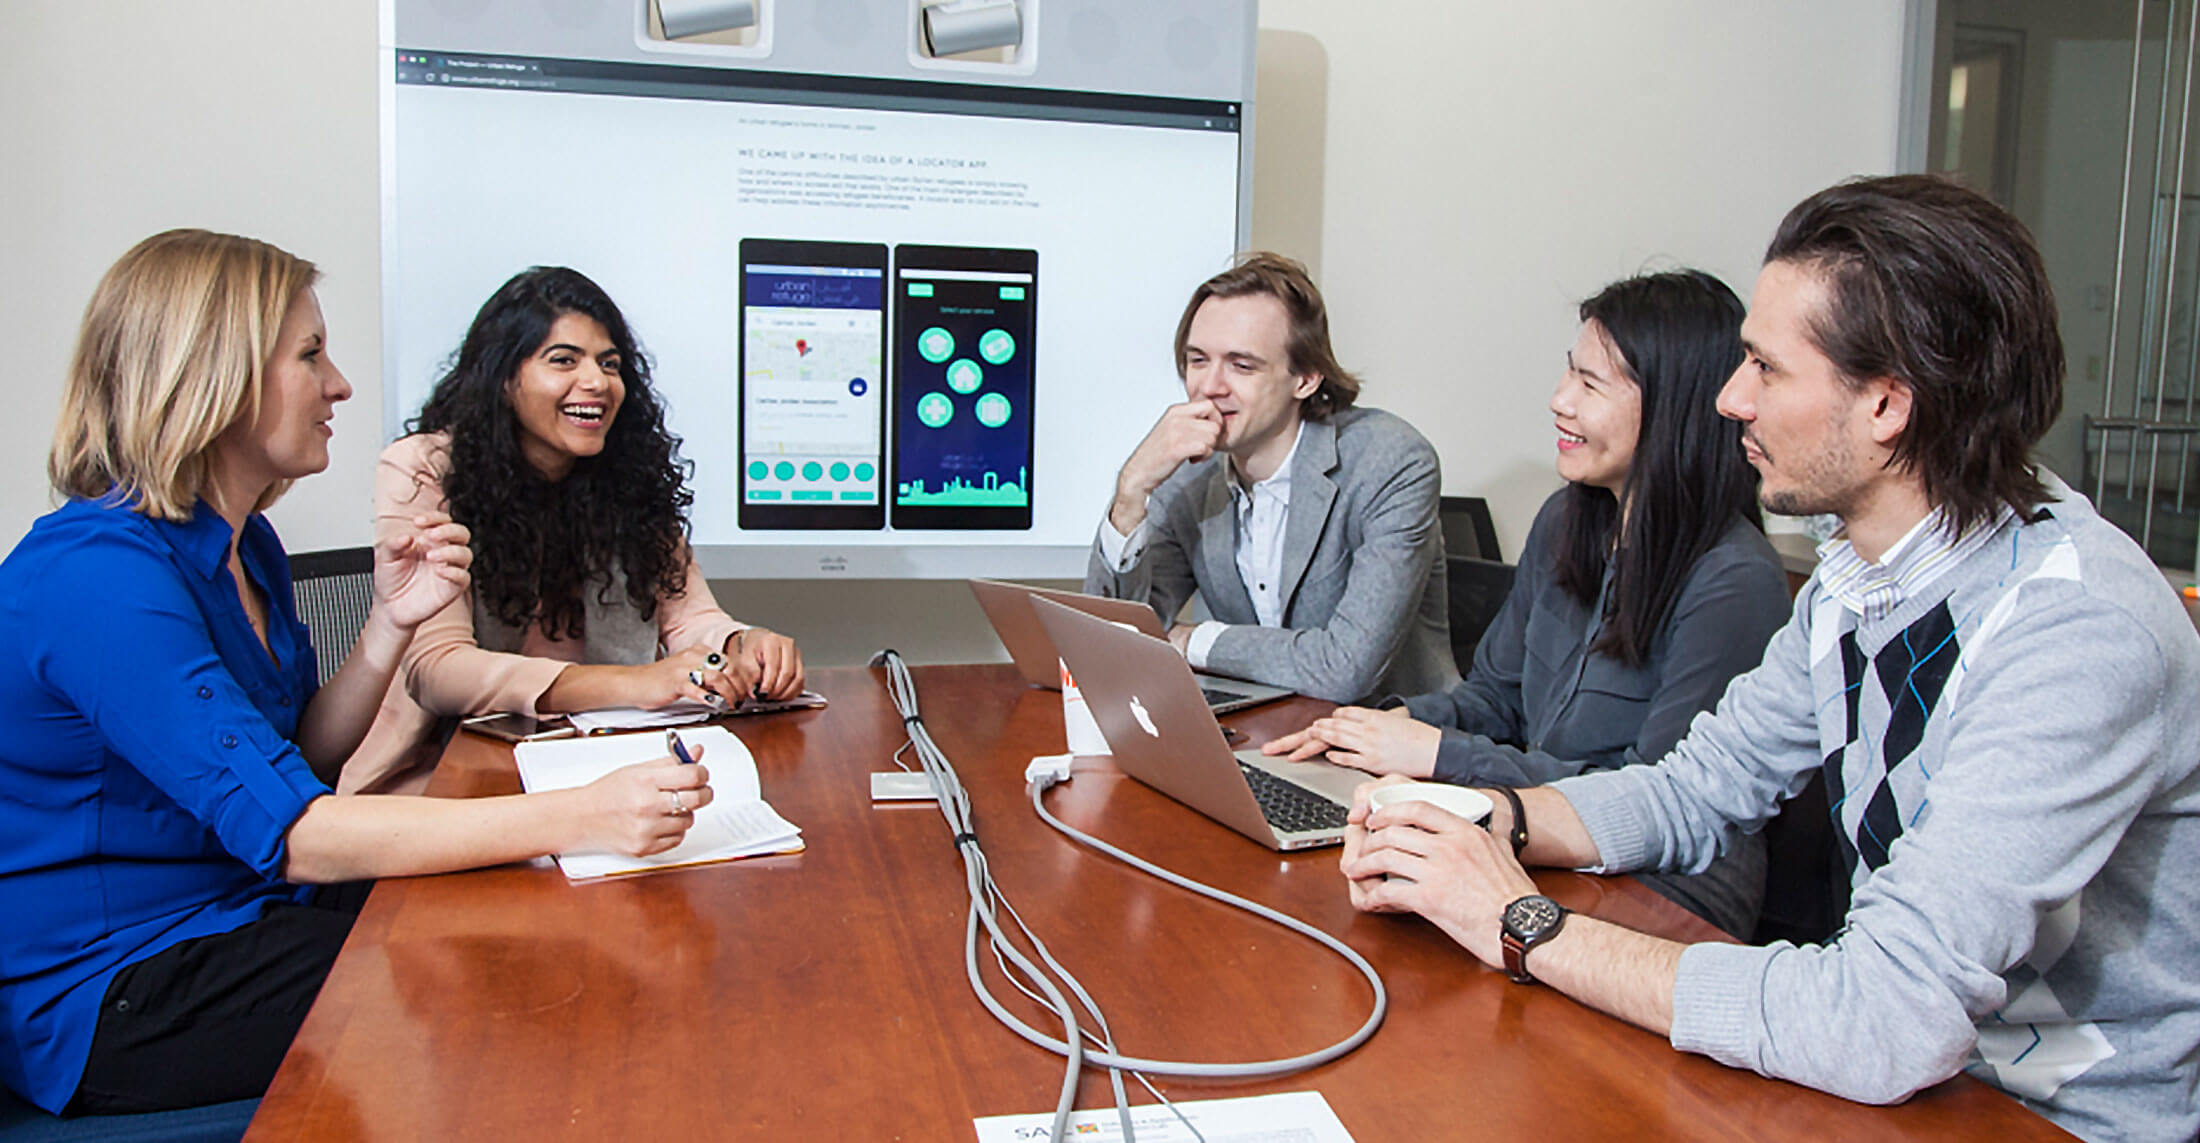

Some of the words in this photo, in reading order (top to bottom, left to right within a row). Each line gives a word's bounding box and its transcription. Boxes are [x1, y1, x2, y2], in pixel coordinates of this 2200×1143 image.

[739, 149, 754, 159] WE
[758, 149, 788, 160] CAME
[791, 151, 805, 160] UP
[809, 152, 836, 162] WITH
[839, 153, 858, 163] THE
[862, 154, 886, 164] IDEA
[889, 155, 903, 165] OF
[917, 158, 965, 169] LOCATOR
[774, 280, 811, 291] urban
[771, 291, 811, 304] refuge
